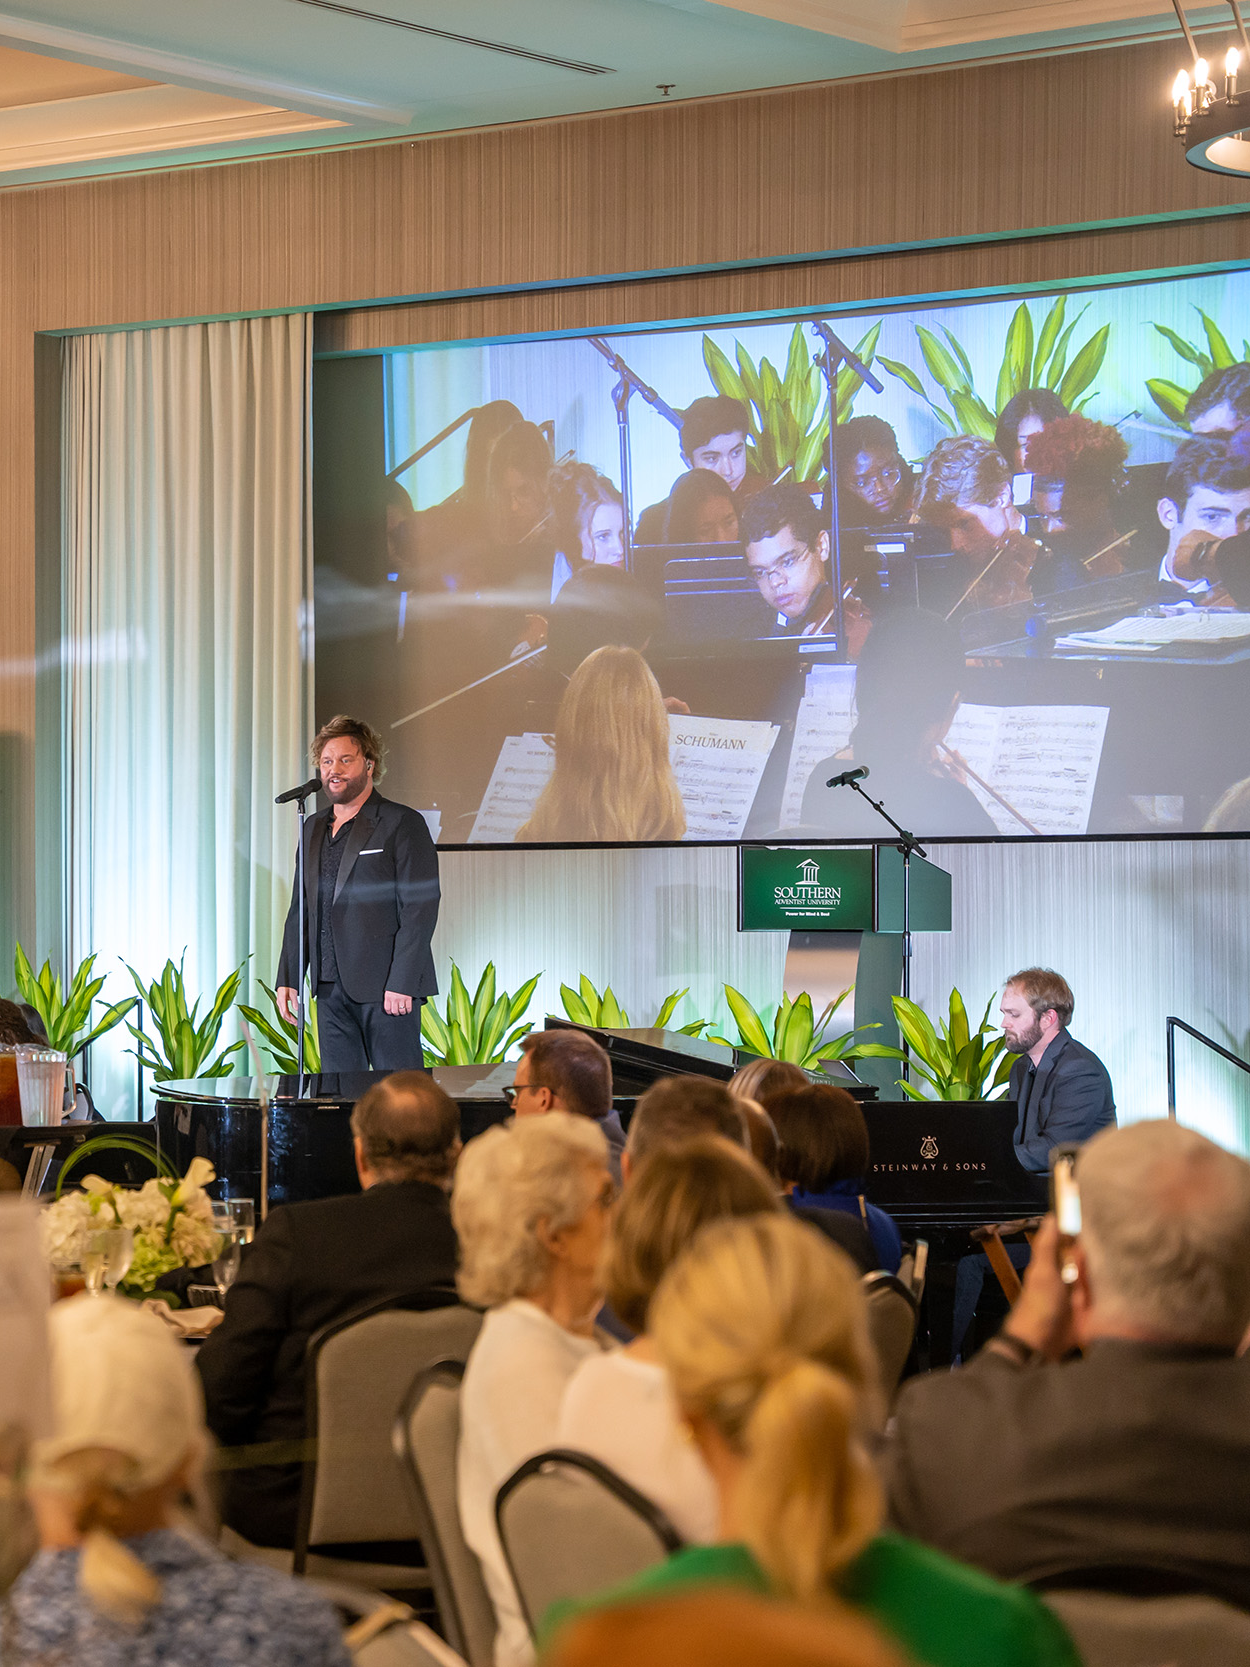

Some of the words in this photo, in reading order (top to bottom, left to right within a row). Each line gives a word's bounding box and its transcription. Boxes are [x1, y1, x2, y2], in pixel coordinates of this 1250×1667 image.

[675, 734, 747, 750] SCHUMANN
[774, 886, 841, 899] SOUTHERN
[873, 1163, 936, 1173] STEINWAY
[942, 1163, 949, 1172] &
[955, 1162, 987, 1172] SONS
